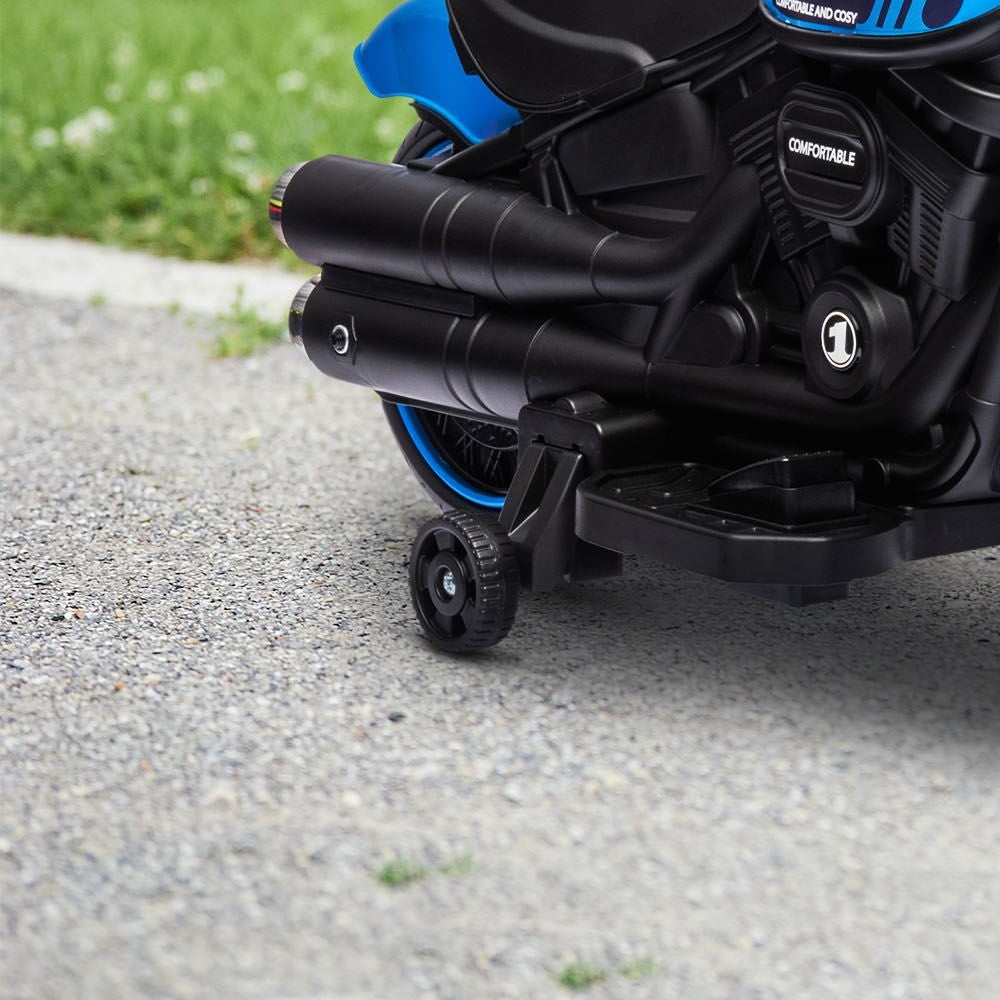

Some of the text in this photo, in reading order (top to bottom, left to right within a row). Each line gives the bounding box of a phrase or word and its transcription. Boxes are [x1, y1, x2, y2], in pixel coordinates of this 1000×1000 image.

[814, 5, 832, 20] AND
[834, 9, 859, 24] COSY
[788, 137, 856, 167] COMFORTABLE
[827, 320, 852, 363] 1
